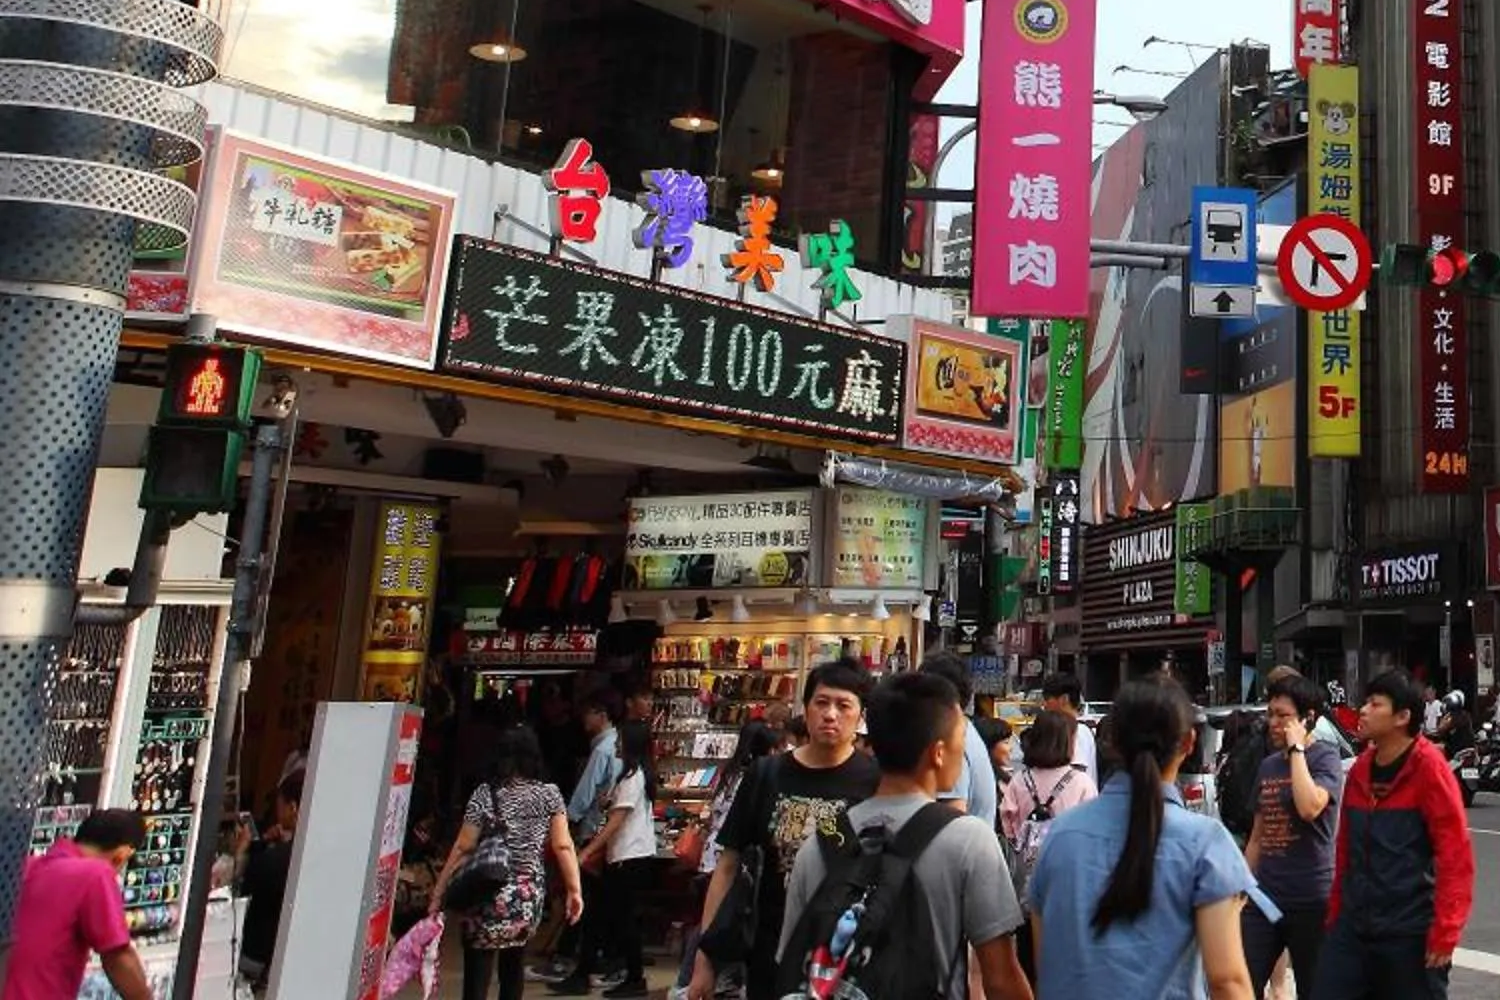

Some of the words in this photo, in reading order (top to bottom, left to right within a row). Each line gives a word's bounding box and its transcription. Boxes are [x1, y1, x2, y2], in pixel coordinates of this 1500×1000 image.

[1425, 41, 1453, 146] 電影館
[1009, 60, 1063, 287] 熊一燒肉
[1429, 174, 1454, 196] 9F
[543, 137, 863, 309] 台灣美味
[1319, 141, 1353, 376] 湯姆世界
[482, 274, 900, 423] 芒果凍100元麻
[1319, 386, 1355, 419] 5F
[1424, 450, 1468, 477] 24H
[1109, 525, 1173, 571] SHINJUKU
[1381, 552, 1439, 585] TISSOT
[1123, 579, 1153, 605] PLAZA
